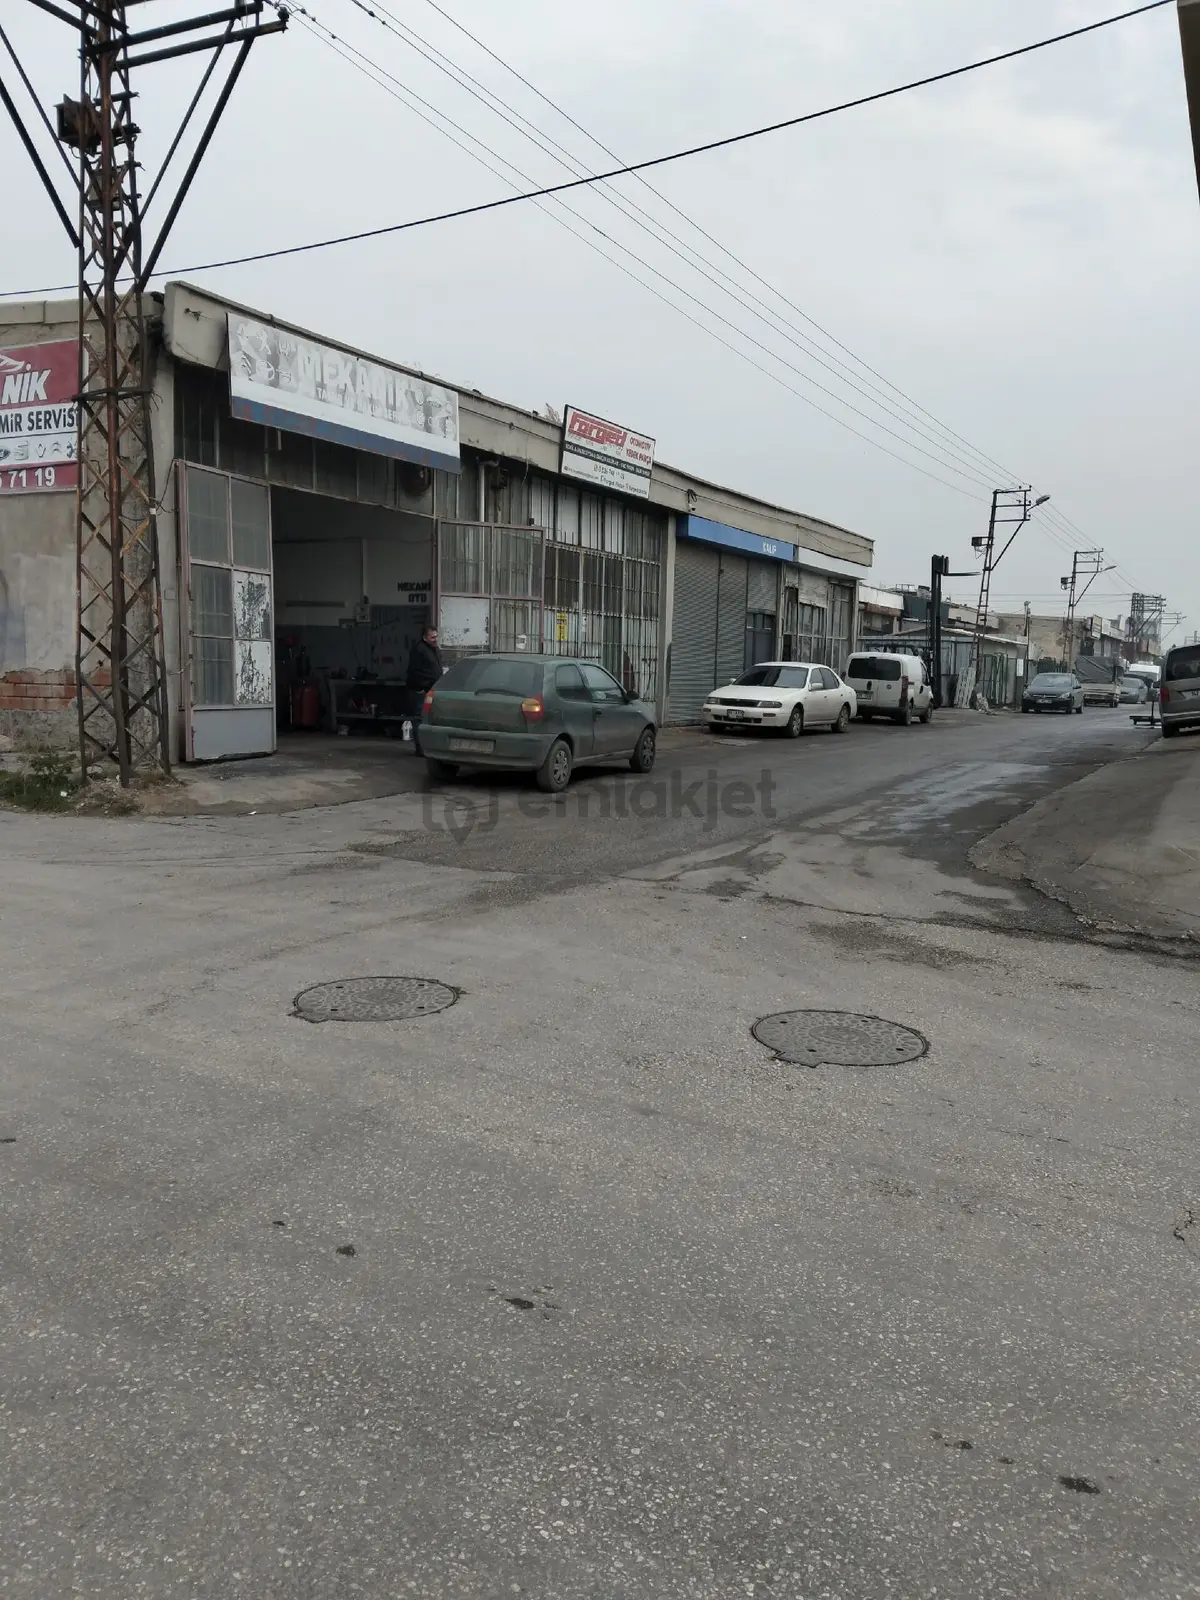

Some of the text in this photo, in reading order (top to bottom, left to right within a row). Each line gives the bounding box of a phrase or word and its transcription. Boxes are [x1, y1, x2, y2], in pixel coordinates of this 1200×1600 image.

[8, 466, 56, 488] 71 19
[408, 592, 427, 603] OTO
